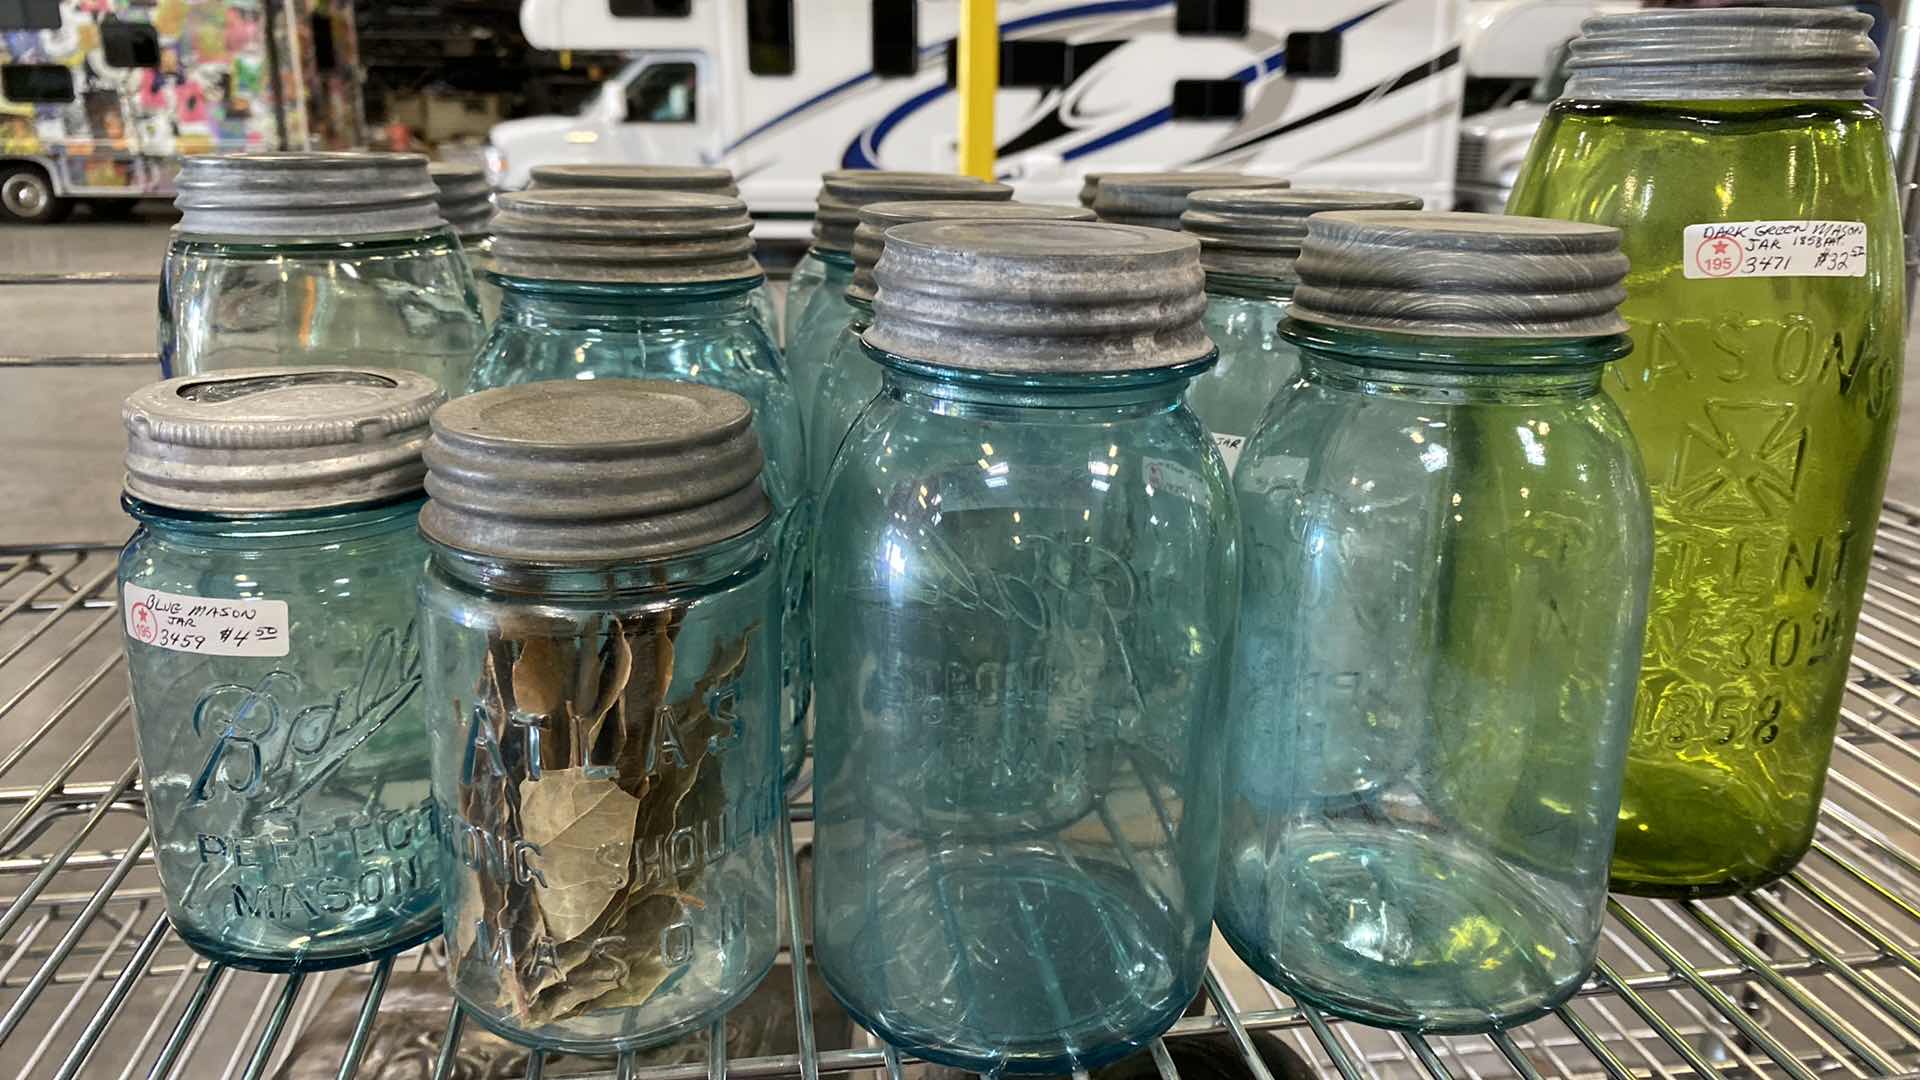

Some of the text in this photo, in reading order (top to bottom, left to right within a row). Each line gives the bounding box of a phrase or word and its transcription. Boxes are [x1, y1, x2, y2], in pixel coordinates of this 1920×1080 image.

[1703, 226, 1747, 239] DARK
[1812, 223, 1863, 237] MASON
[1745, 238, 1781, 252] JAR
[1705, 257, 1732, 271] 195
[1742, 256, 1792, 274] 3471
[146, 594, 257, 621] BLUE MASON
[168, 616, 197, 628] JAR
[160, 629, 206, 650] 3459
[462, 688, 744, 786] ATLAS
[231, 855, 419, 918] MASON
